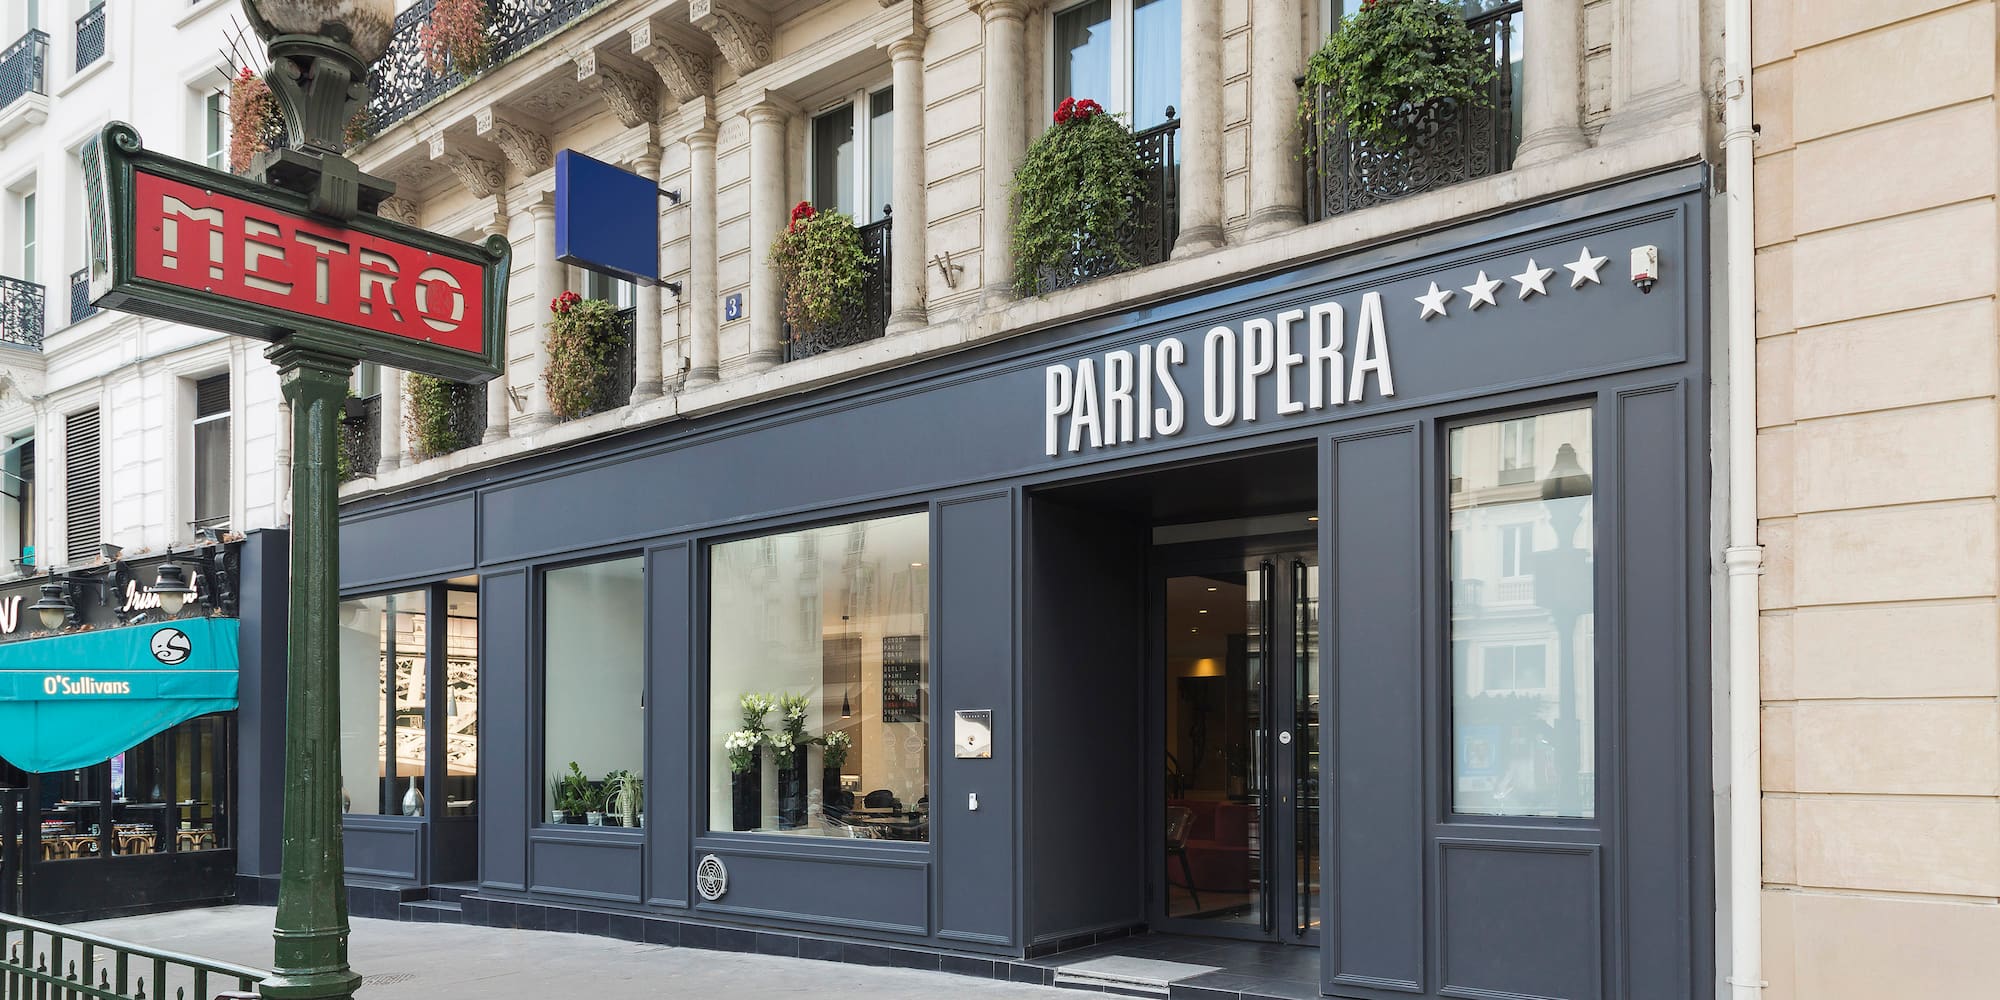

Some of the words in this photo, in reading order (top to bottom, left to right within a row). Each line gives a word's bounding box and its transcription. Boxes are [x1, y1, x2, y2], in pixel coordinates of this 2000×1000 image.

[162, 194, 465, 332] METRO
[729, 298, 738, 316] 3
[1045, 337, 1185, 456] PARIS
[1203, 290, 1396, 428] OPERA
[43, 674, 131, 695] O'Sullivans
